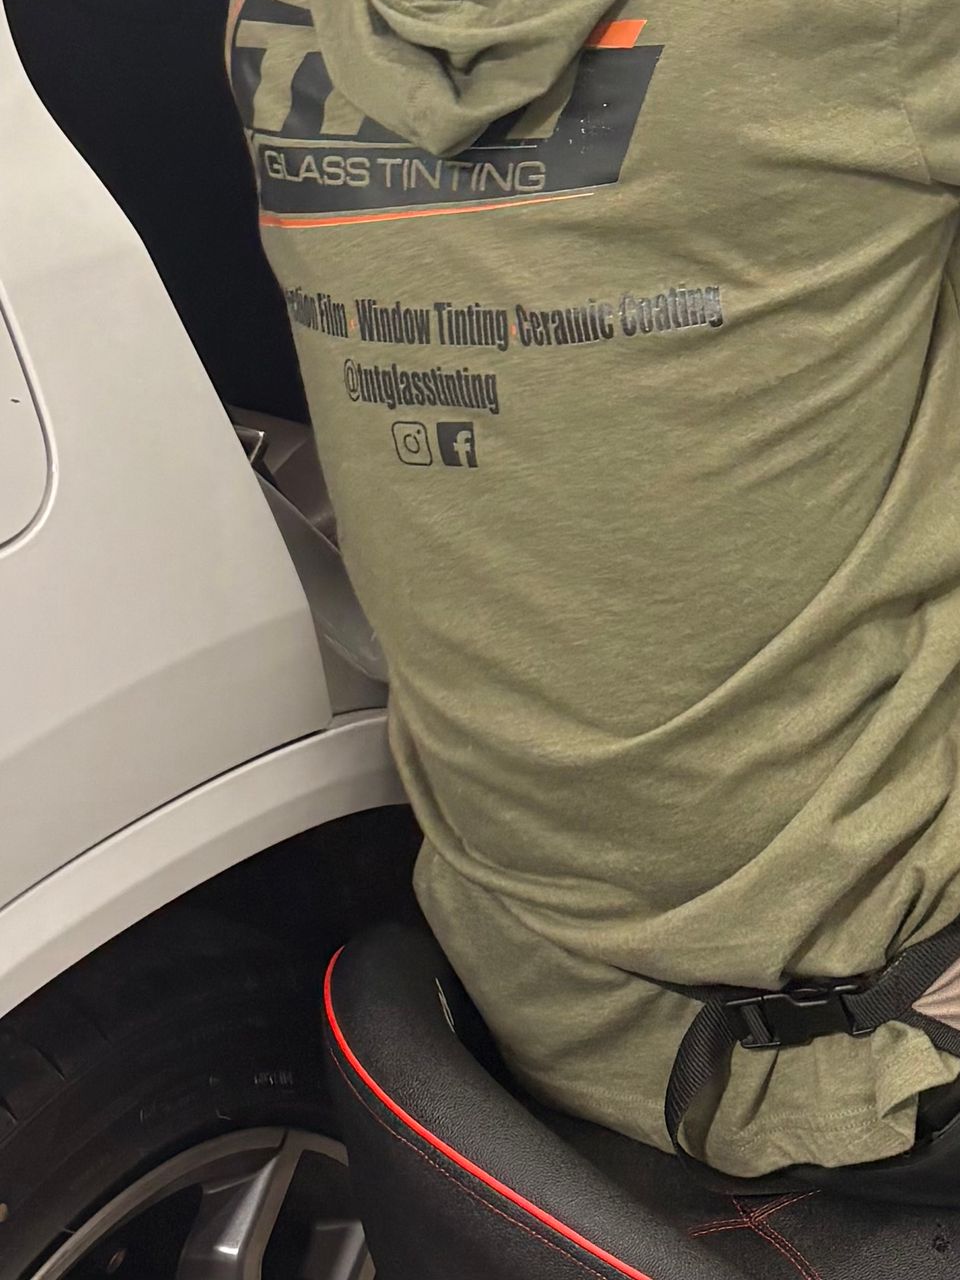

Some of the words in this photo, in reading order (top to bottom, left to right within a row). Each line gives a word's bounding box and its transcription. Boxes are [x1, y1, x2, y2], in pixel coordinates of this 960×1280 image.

[264, 150, 370, 188] GLASS
[376, 158, 547, 193] TINTING
[317, 293, 349, 338] Film
[355, 299, 431, 345] Window
[434, 301, 510, 352] Tinting
[516, 298, 614, 347] Ceramic
[620, 283, 724, 336] Coating
[344, 359, 499, 414] @tntglasstinting
